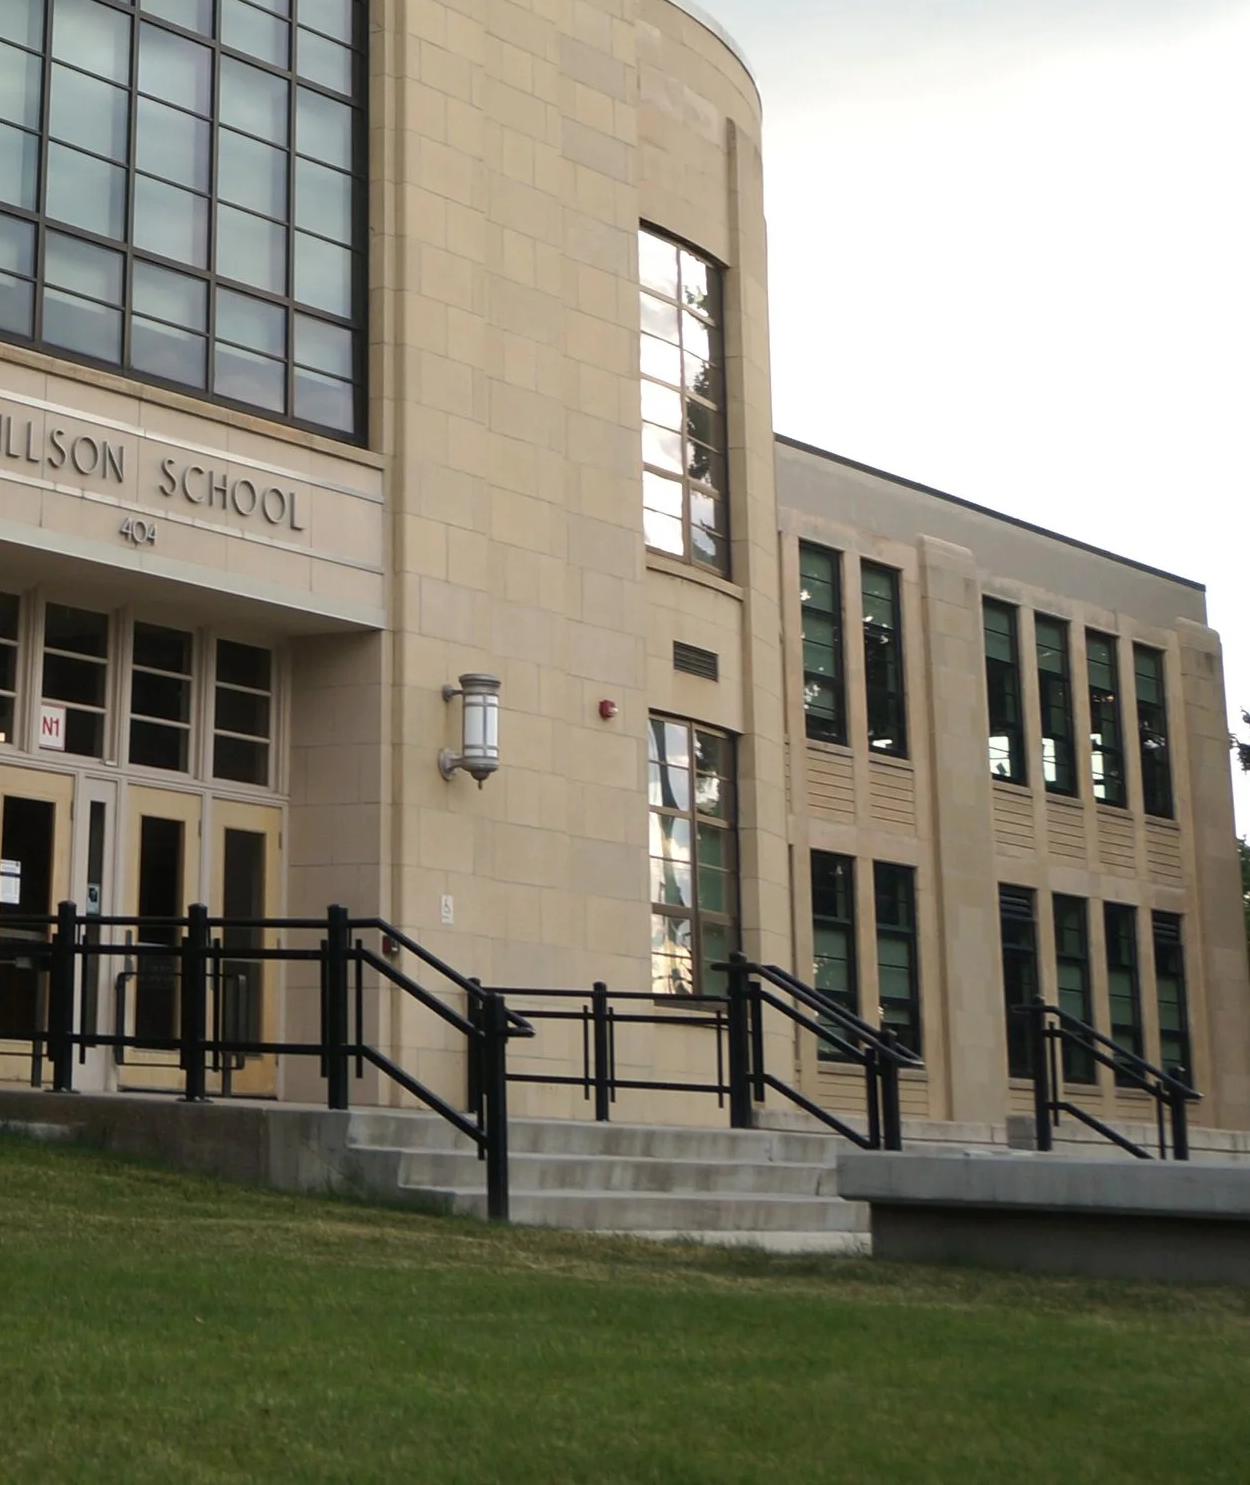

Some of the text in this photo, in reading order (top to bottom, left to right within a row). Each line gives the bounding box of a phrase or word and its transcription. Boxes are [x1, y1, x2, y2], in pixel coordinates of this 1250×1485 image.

[158, 457, 304, 532] SCHOOL
[119, 517, 157, 546] 404
[42, 715, 59, 737] N1
